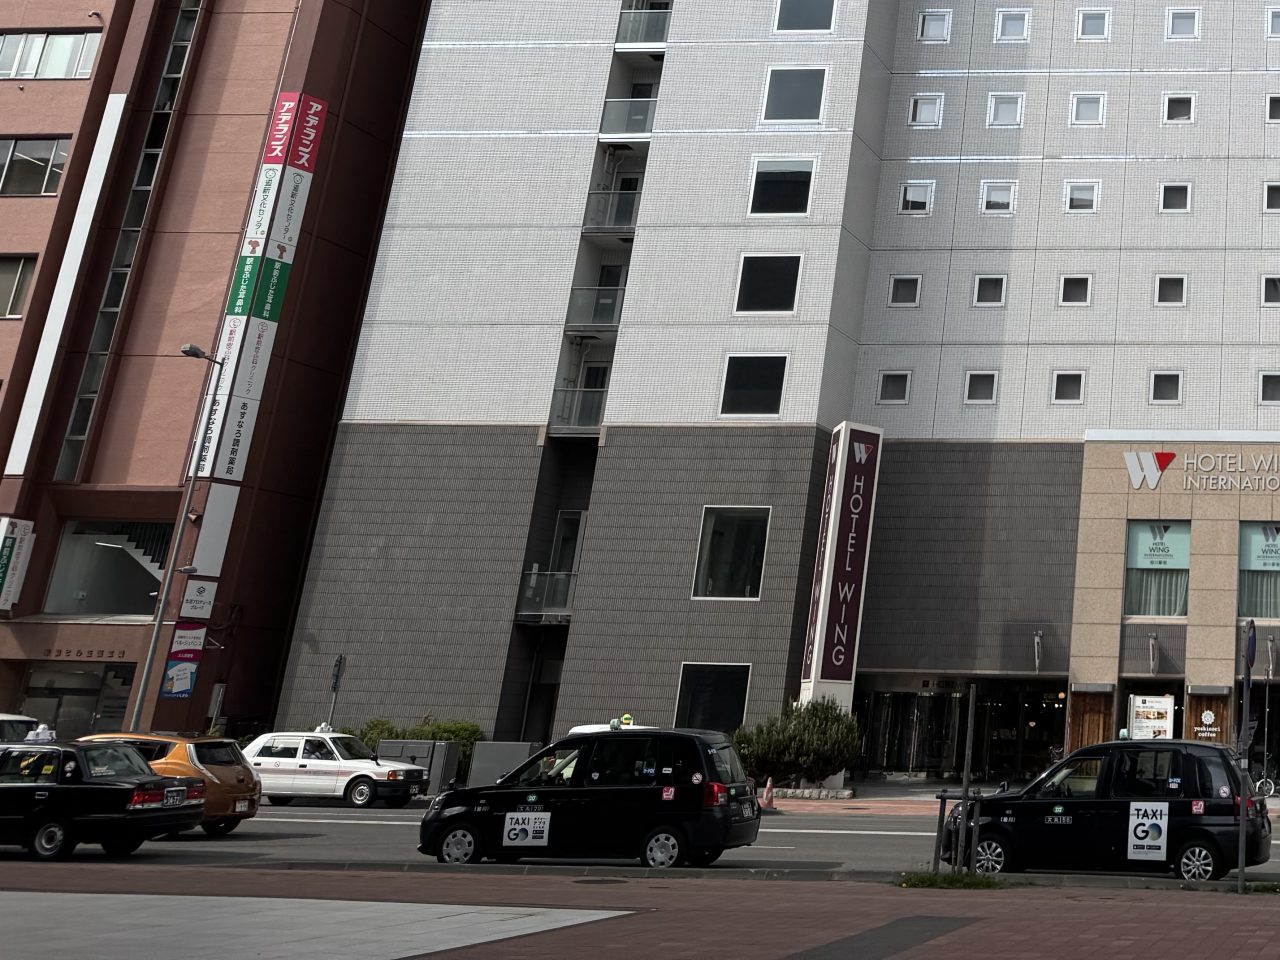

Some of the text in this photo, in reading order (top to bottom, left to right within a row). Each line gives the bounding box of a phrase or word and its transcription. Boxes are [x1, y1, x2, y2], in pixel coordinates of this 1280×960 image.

[268, 101, 296, 158] アデランス
[294, 101, 323, 168] アデランス
[1183, 453, 1246, 474] HOTEL
[845, 474, 865, 572] HOTEL
[831, 581, 856, 667] WING
[509, 817, 530, 826] TAXI
[1134, 808, 1163, 820] TAXI
